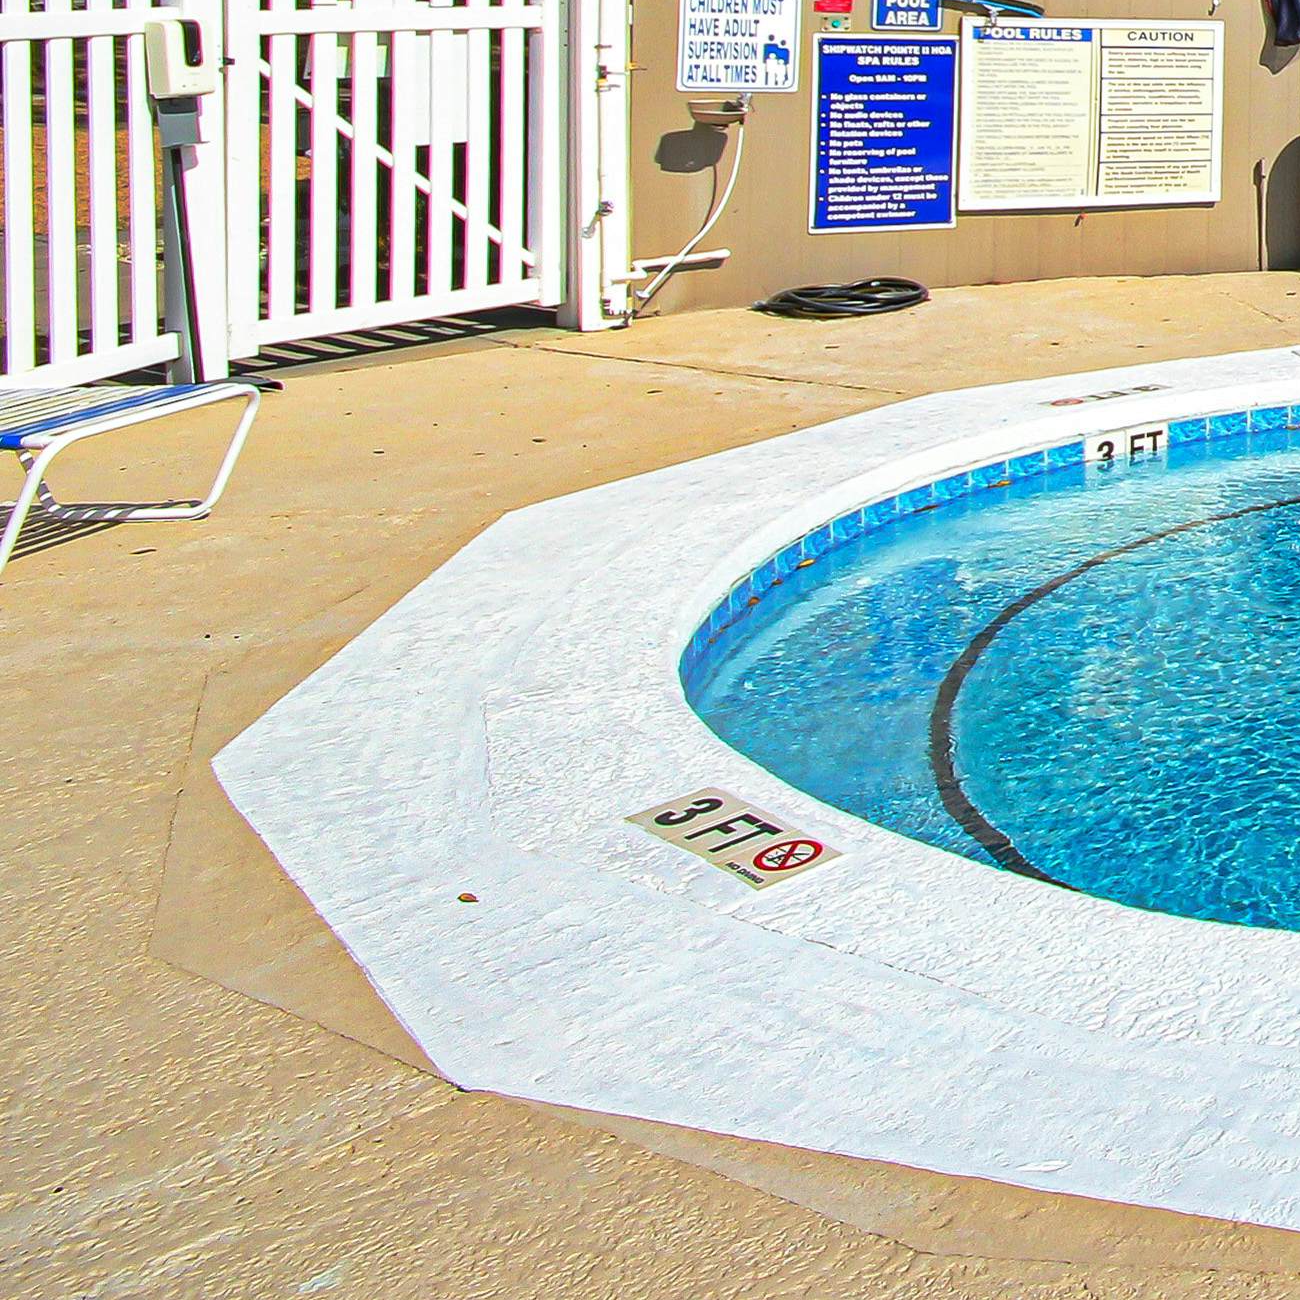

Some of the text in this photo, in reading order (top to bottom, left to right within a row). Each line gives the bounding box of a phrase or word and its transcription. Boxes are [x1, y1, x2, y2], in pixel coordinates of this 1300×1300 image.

[885, 11, 930, 26] AREA
[689, 18, 760, 37] HAVE ADULT
[1029, 28, 1083, 40] RULES
[1127, 31, 1194, 41] CAUTION
[688, 41, 758, 60] SUPERVISION
[822, 44, 882, 55] SHIPWATCH
[884, 45, 920, 55] POINTE
[931, 46, 952, 55] HOA
[857, 56, 919, 66] SPA RULES
[687, 64, 758, 83] AT ALL TIMES
[849, 74, 874, 84] Open
[830, 93, 843, 101] No
[844, 93, 868, 102] glass
[869, 93, 915, 101] containers
[830, 102, 864, 111] objects
[829, 111, 904, 119] No audio devices
[829, 120, 843, 128] No
[907, 120, 931, 128] other
[869, 129, 903, 137] devices
[829, 139, 863, 148] No pets
[843, 148, 885, 157] reserving
[886, 147, 896, 155] of
[896, 147, 916, 156] pool
[829, 158, 868, 166] furniture
[828, 167, 841, 175] No
[869, 166, 912, 174] umbrellas
[895, 175, 924, 183] except
[828, 184, 936, 194] provided by management
[827, 203, 886, 211] accompanied
[1097, 430, 1163, 463] 3 FT
[654, 798, 784, 853] 3 FT
[725, 862, 765, 884] NO DIVING
